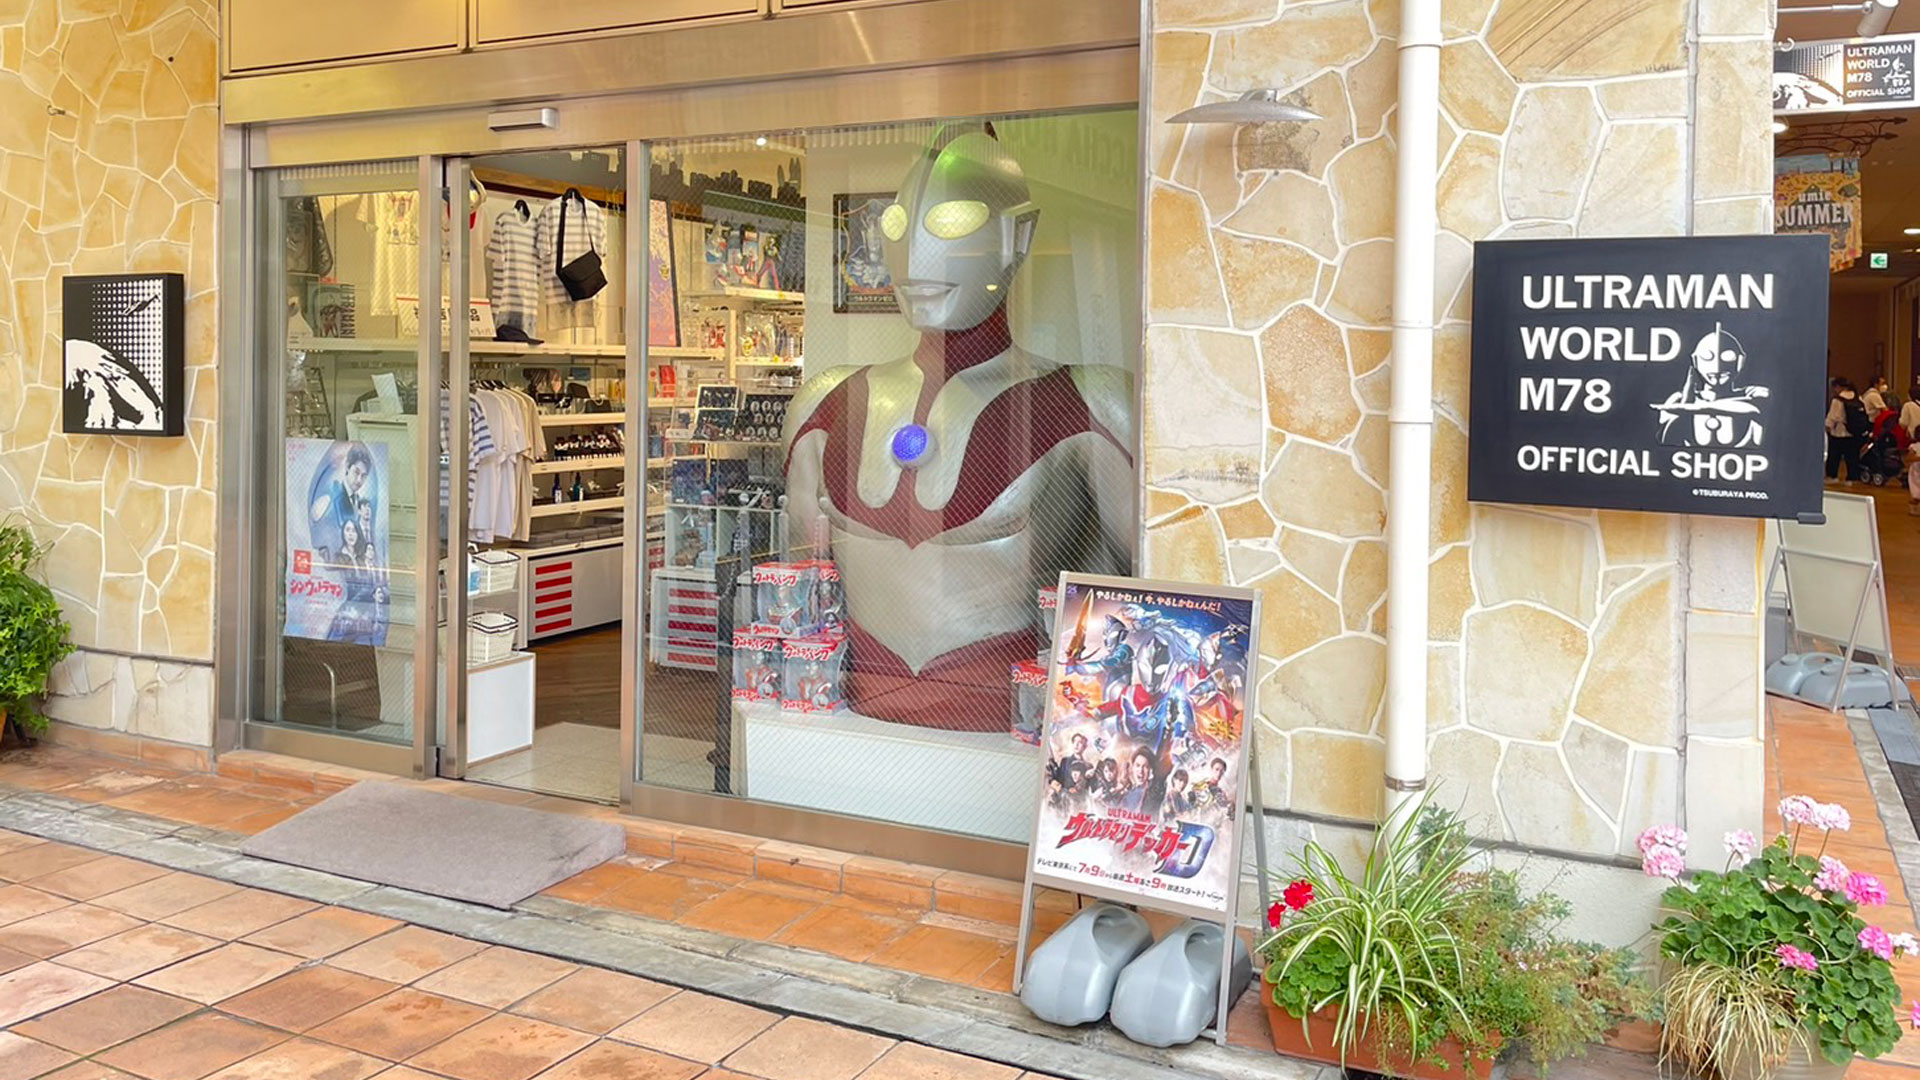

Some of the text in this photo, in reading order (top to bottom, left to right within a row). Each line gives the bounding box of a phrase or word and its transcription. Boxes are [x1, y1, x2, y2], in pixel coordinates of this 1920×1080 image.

[1847, 44, 1912, 58] ULTRAMAN
[1846, 57, 1890, 70] WORLD
[1846, 71, 1873, 84] M78
[1846, 86, 1912, 98] OFFICIAL SHOP
[1775, 203, 1853, 228] SUMMER
[1522, 273, 1774, 310] ULTRAMAN
[1520, 326, 1682, 362] WORLD
[1519, 377, 1612, 414] M78
[1517, 444, 1769, 482] OFFICIAL SHOP
[1107, 807, 1152, 822] ULTRAMAN
